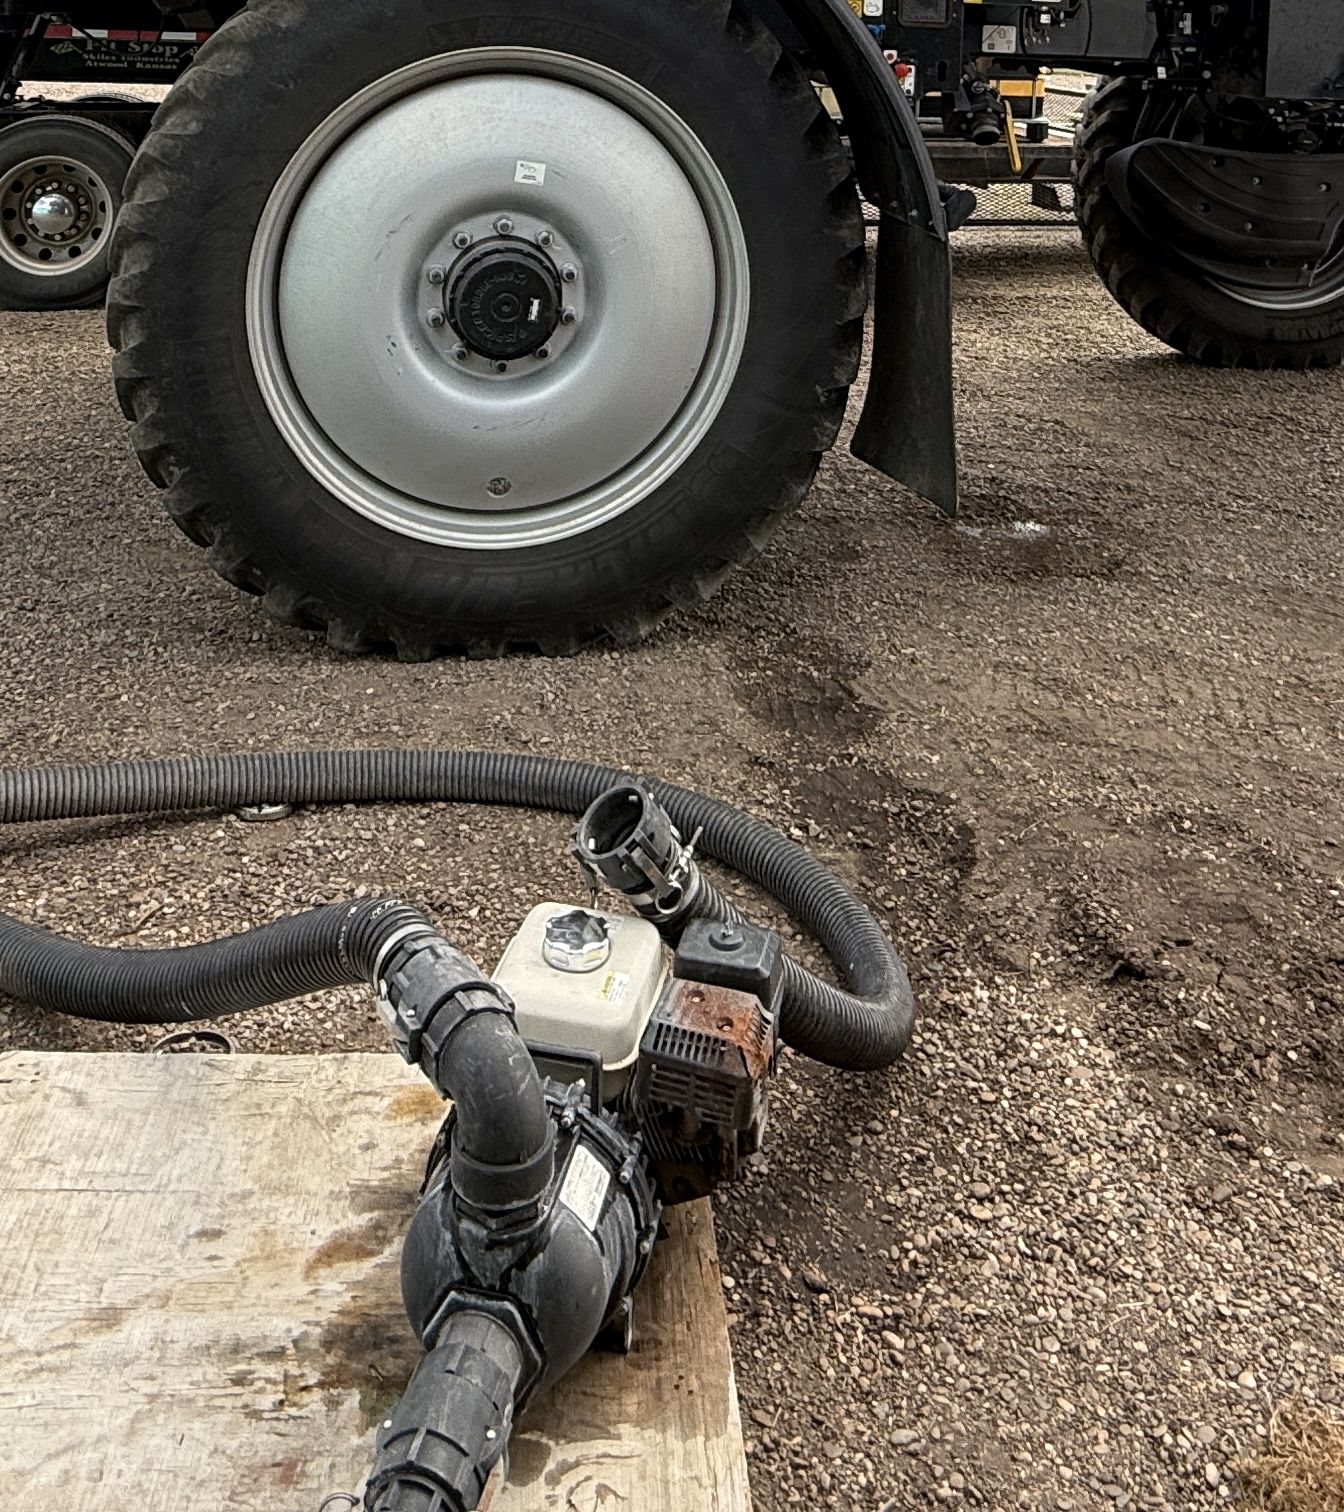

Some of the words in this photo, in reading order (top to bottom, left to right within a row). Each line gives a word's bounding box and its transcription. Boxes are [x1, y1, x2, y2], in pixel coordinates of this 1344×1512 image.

[128, 41, 178, 57] Stop
[122, 55, 180, 63] Industries
[85, 60, 128, 68] Atwood
[136, 61, 177, 69] Kansas
